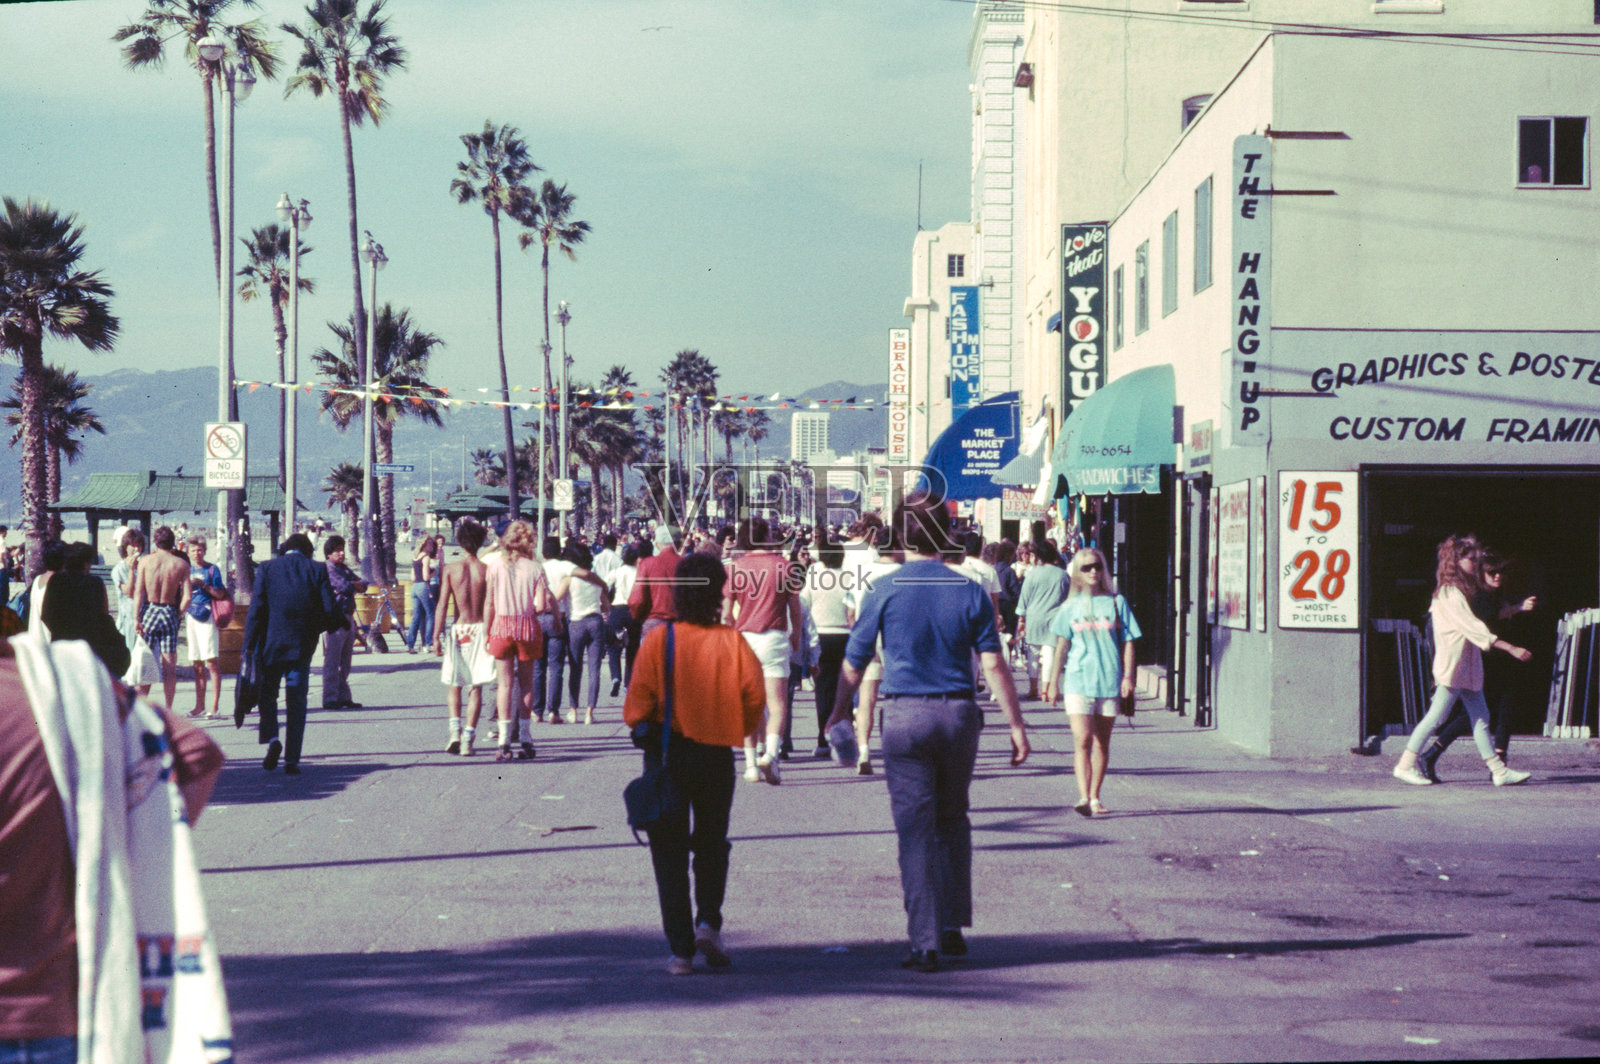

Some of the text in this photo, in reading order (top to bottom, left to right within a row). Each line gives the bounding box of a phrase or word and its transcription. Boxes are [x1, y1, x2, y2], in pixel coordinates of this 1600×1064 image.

[1238, 153, 1262, 219] THE
[1066, 248, 1103, 278] that
[951, 292, 968, 382] FASHION
[1069, 286, 1099, 411] YOGU
[892, 341, 906, 394] BEACH
[967, 333, 979, 376] MISS
[1311, 351, 1600, 392] GRAPHICS & POSTE
[892, 401, 906, 454] HOUSE
[974, 428, 995, 438] THE
[1329, 415, 1467, 441] CUSTOM
[961, 439, 1005, 449] MARKET
[967, 450, 1000, 459] PLACE
[208, 471, 241, 480] BICYCLES
[217, 462, 231, 470] NO
[1281, 479, 1344, 533] $15
[1305, 535, 1328, 545] TO
[1282, 548, 1351, 602] $28
[1292, 614, 1347, 623] PICTURES
[1304, 603, 1330, 612] MOST
